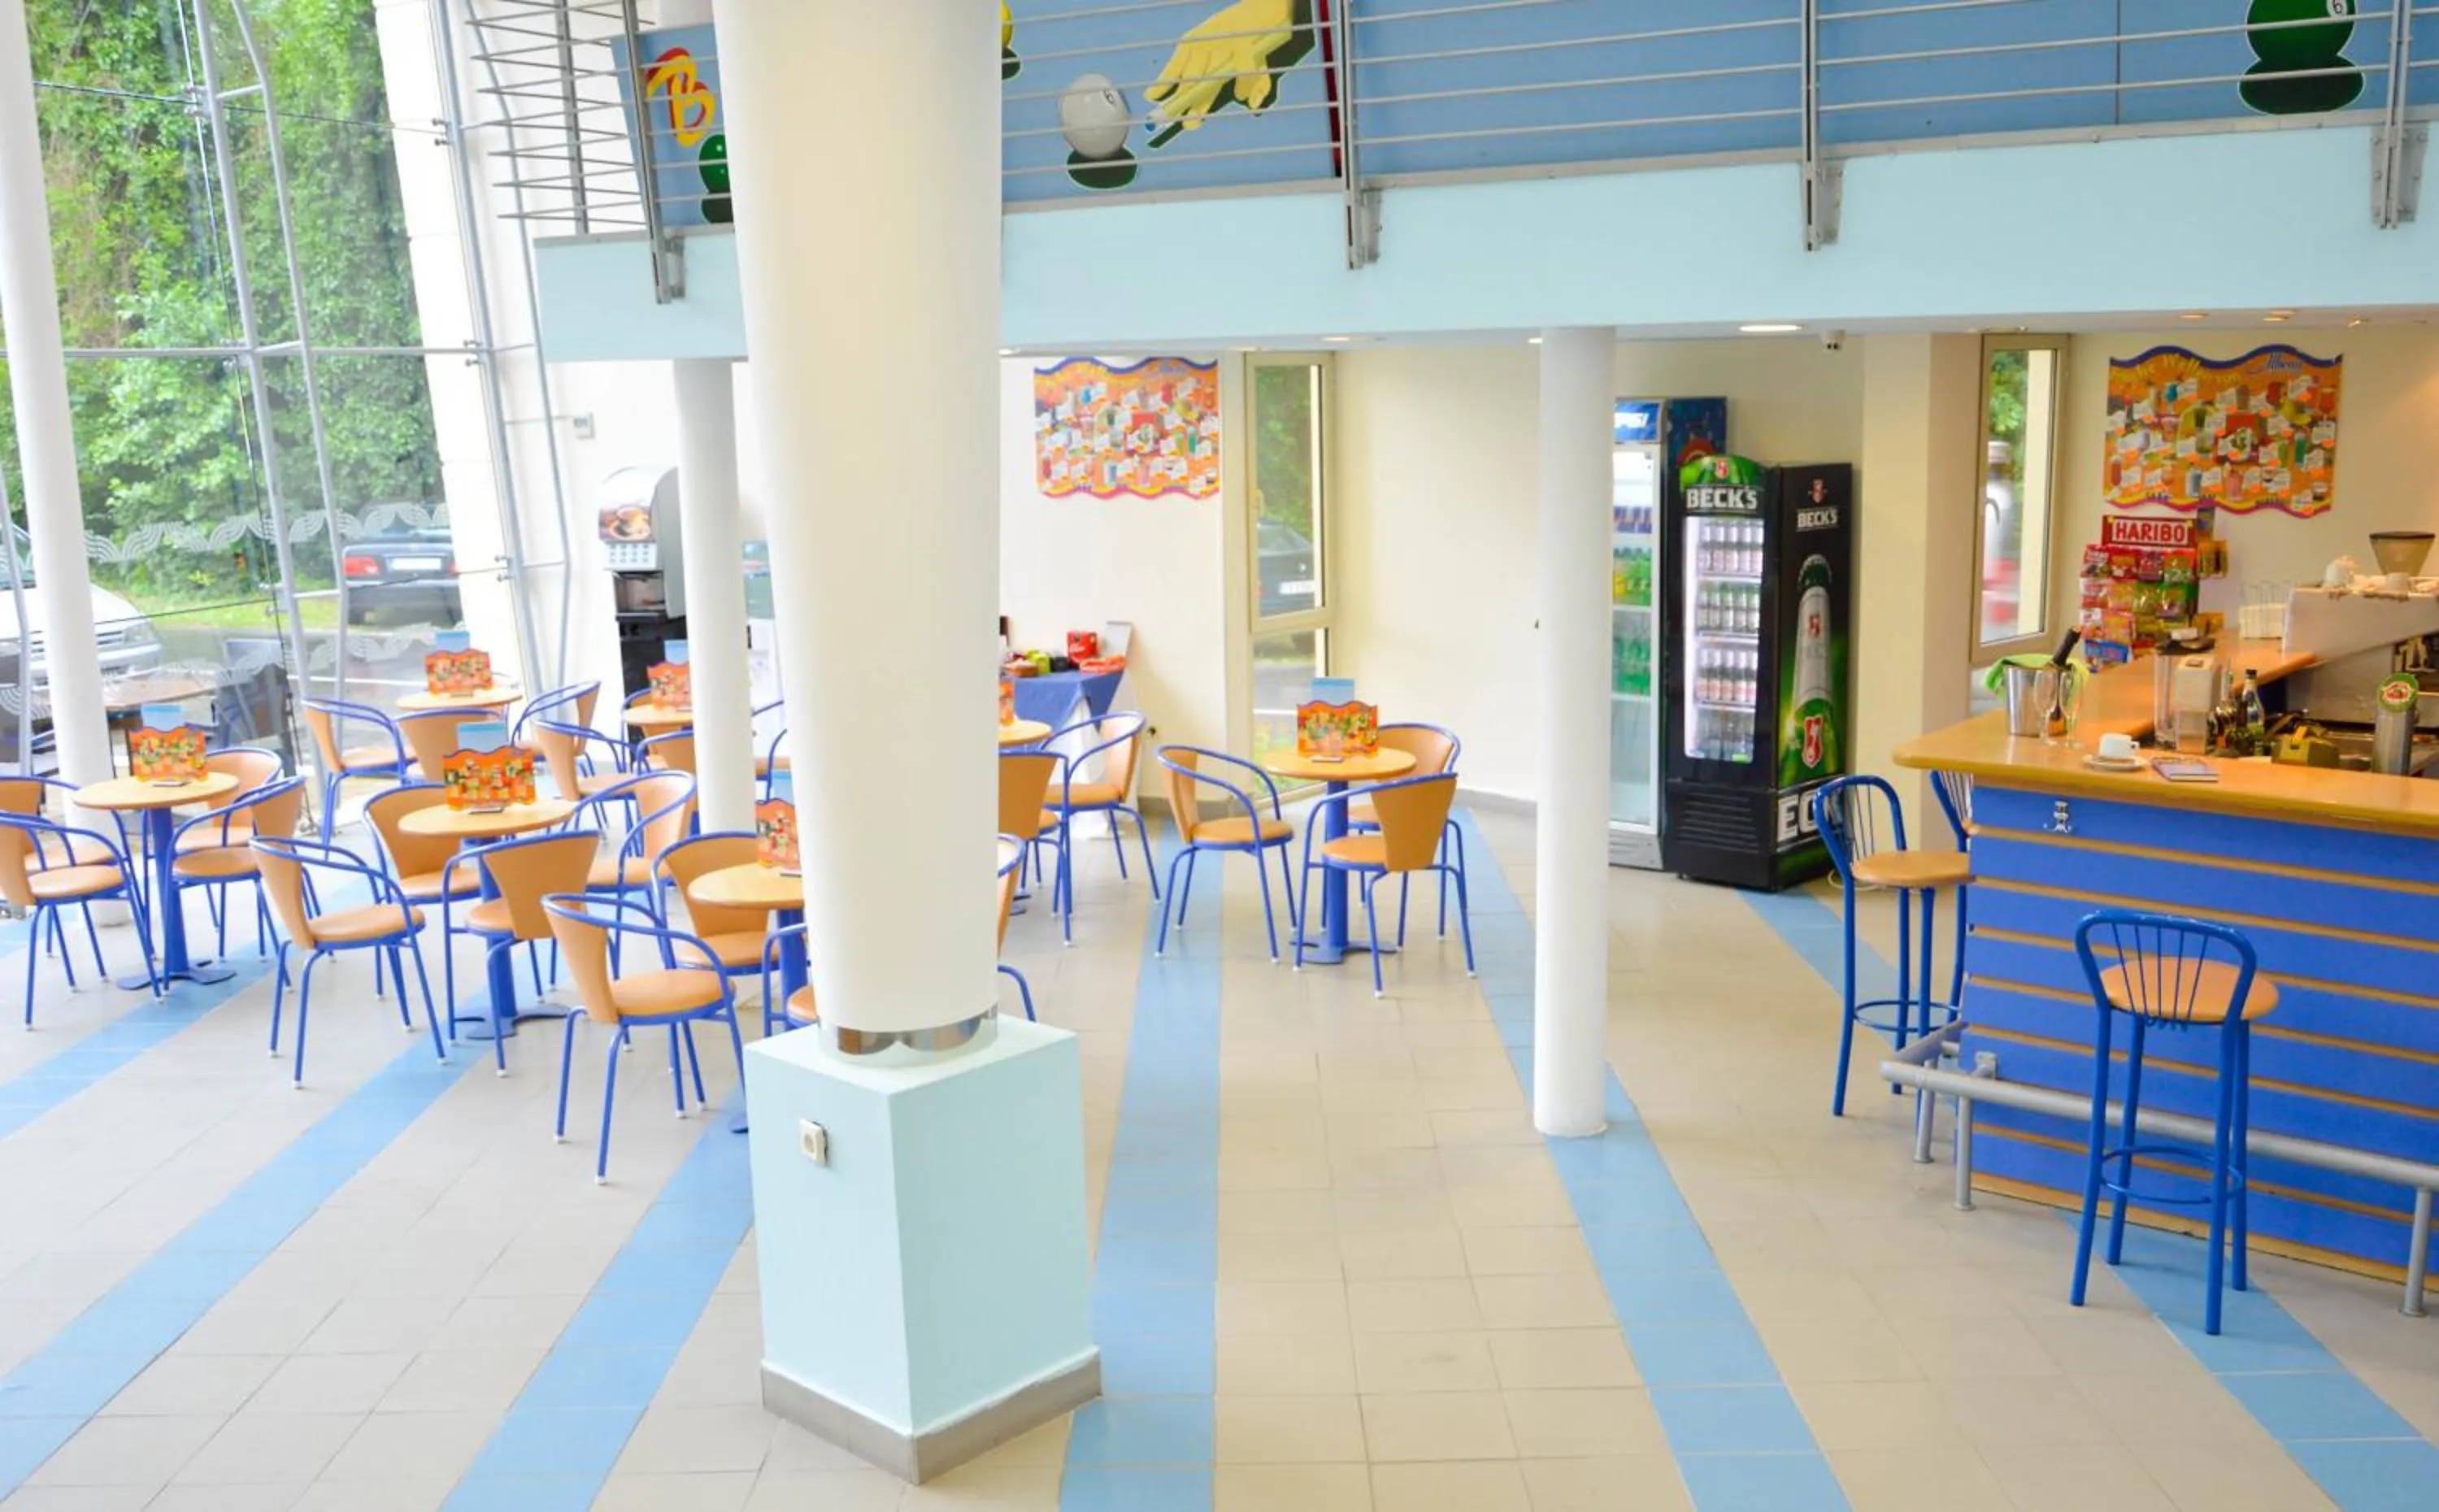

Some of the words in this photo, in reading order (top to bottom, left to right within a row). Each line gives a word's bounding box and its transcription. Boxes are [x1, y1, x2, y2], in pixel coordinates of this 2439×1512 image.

[1686, 486, 1758, 509] BECK'S
[1797, 508, 1839, 528] BECK'S
[2115, 521, 2185, 543] HARIBO
